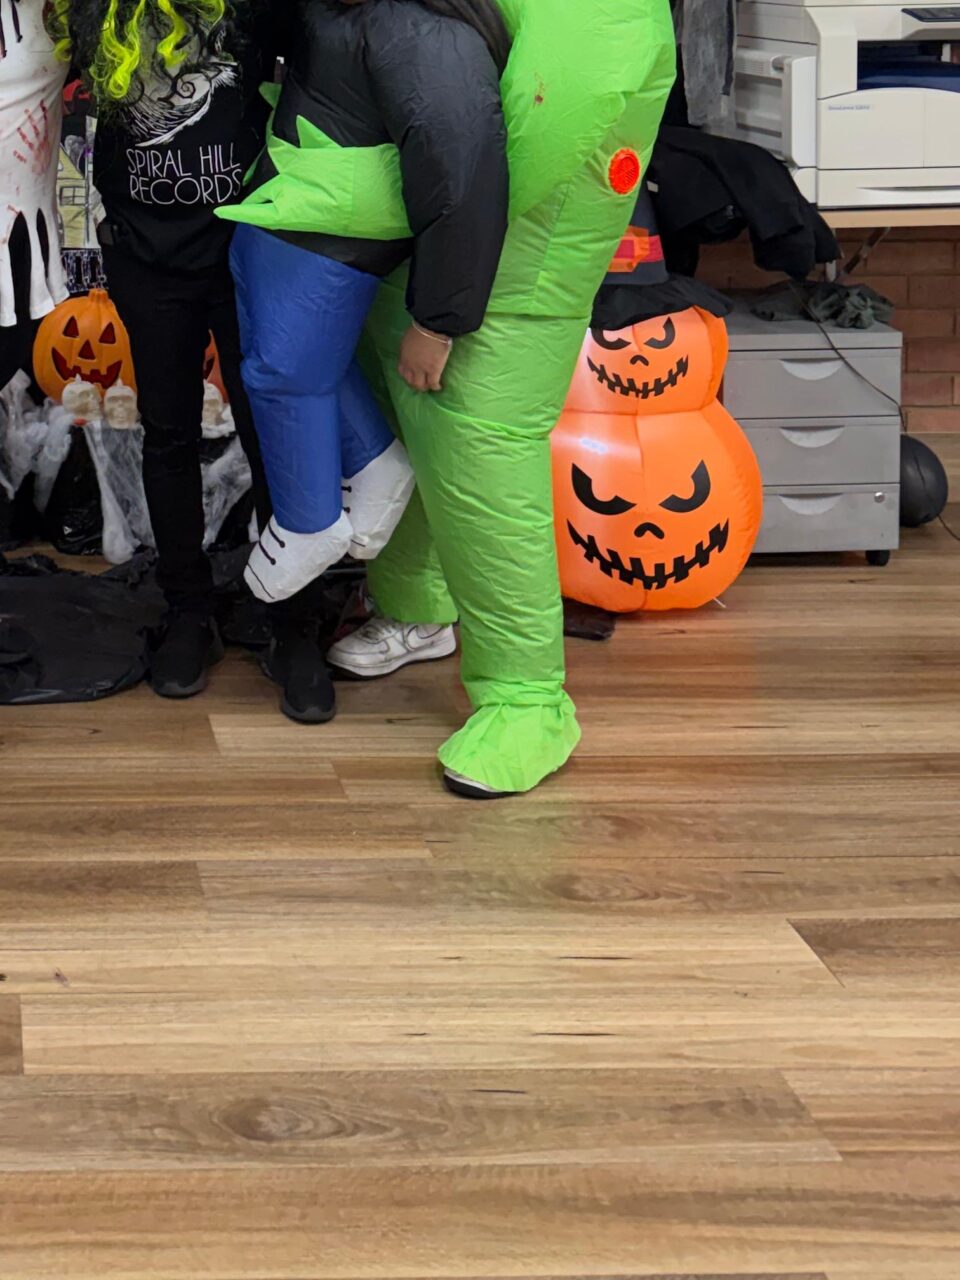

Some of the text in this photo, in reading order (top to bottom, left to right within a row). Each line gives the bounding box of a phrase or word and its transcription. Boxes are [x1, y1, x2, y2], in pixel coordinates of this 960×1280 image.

[126, 142, 241, 178] SPIRAL HILL
[129, 169, 242, 205] RECORDS
